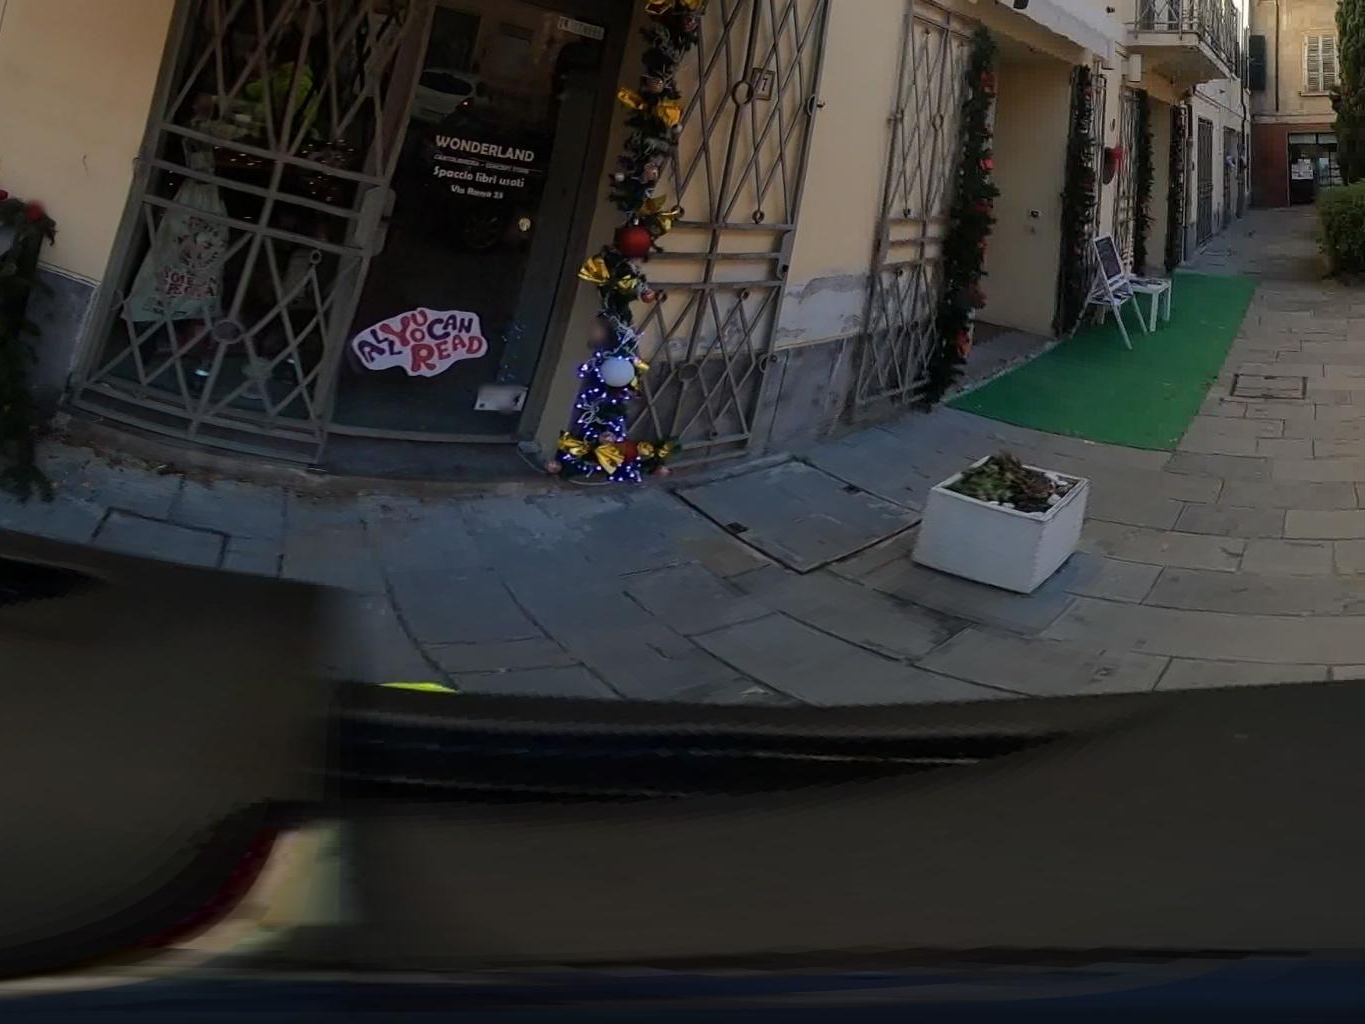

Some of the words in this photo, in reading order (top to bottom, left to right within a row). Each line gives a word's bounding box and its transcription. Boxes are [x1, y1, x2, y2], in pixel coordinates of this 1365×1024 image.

[435, 135, 535, 162] WONDERLAND
[433, 166, 473, 179] Spaccio
[475, 172, 497, 184] libri
[357, 329, 403, 363] ALL
[427, 314, 473, 340] CAN
[410, 335, 483, 372] READ
